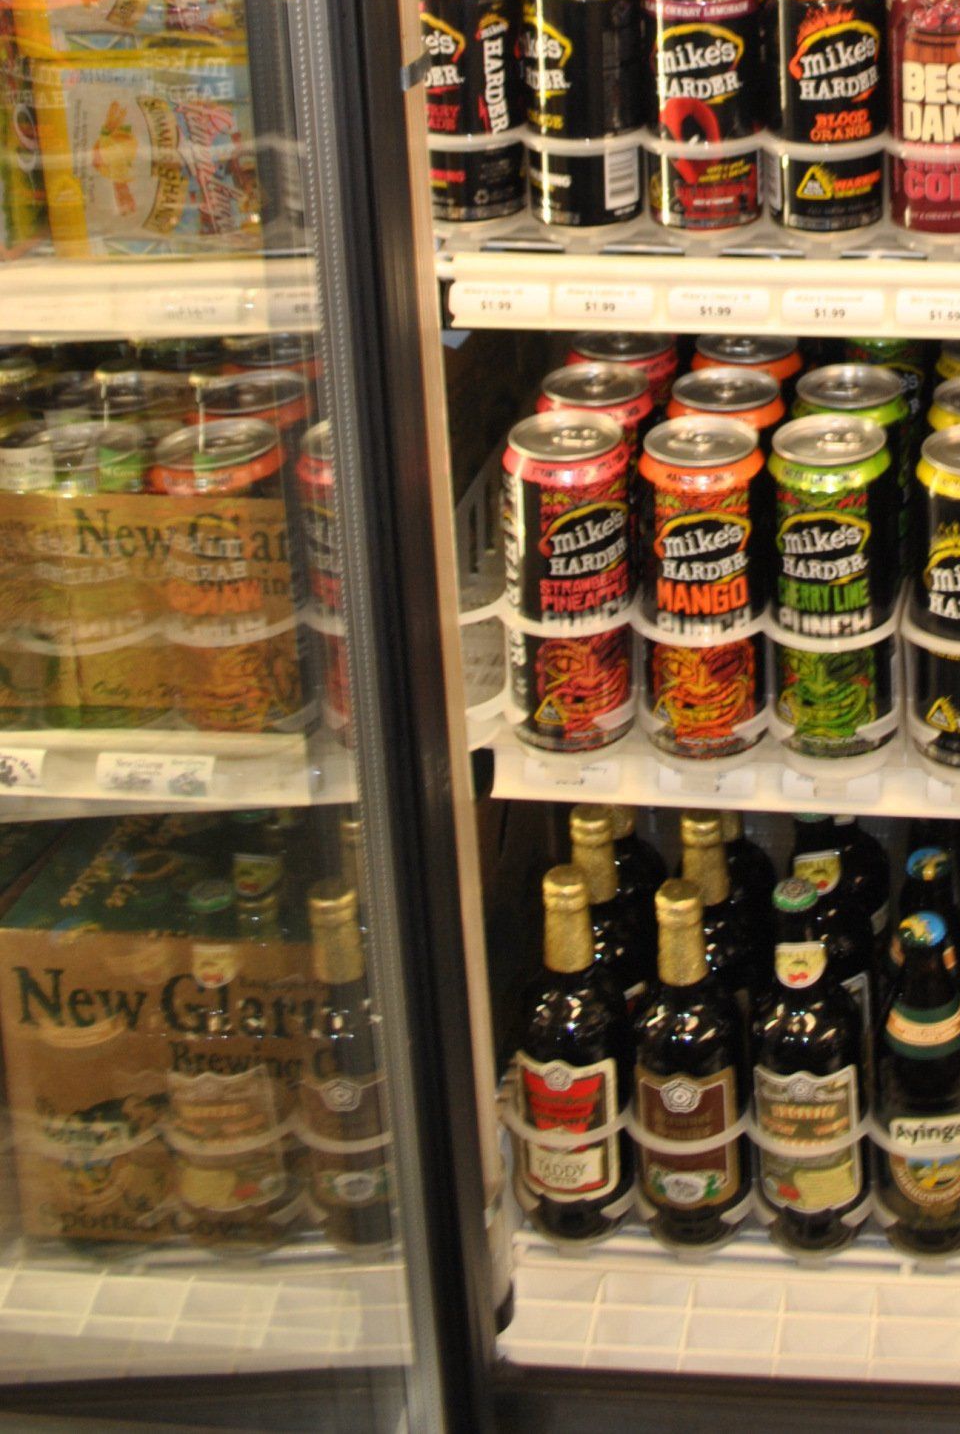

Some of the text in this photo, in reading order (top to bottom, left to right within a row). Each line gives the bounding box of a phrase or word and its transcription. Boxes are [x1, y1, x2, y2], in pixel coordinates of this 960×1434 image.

[657, 39, 737, 73] mike's
[802, 36, 877, 78] mike's
[483, 39, 510, 135] HARDER
[657, 70, 740, 99] HARDER
[800, 66, 880, 101] HARDER
[810, 123, 872, 143] ORANGE
[814, 109, 868, 127] BLOOD
[700, 306, 732, 317] $1.99
[815, 308, 846, 318] $1.99
[73, 508, 174, 559] New
[550, 510, 625, 555] mike's
[662, 523, 745, 558] mike's
[782, 523, 862, 554] mike's
[549, 536, 628, 576] HARDER
[661, 550, 748, 581] HARDER
[782, 553, 867, 581] HARDER
[656, 576, 748, 615] MANGO
[834, 577, 871, 612] LIME
[15, 968, 148, 1032] New
